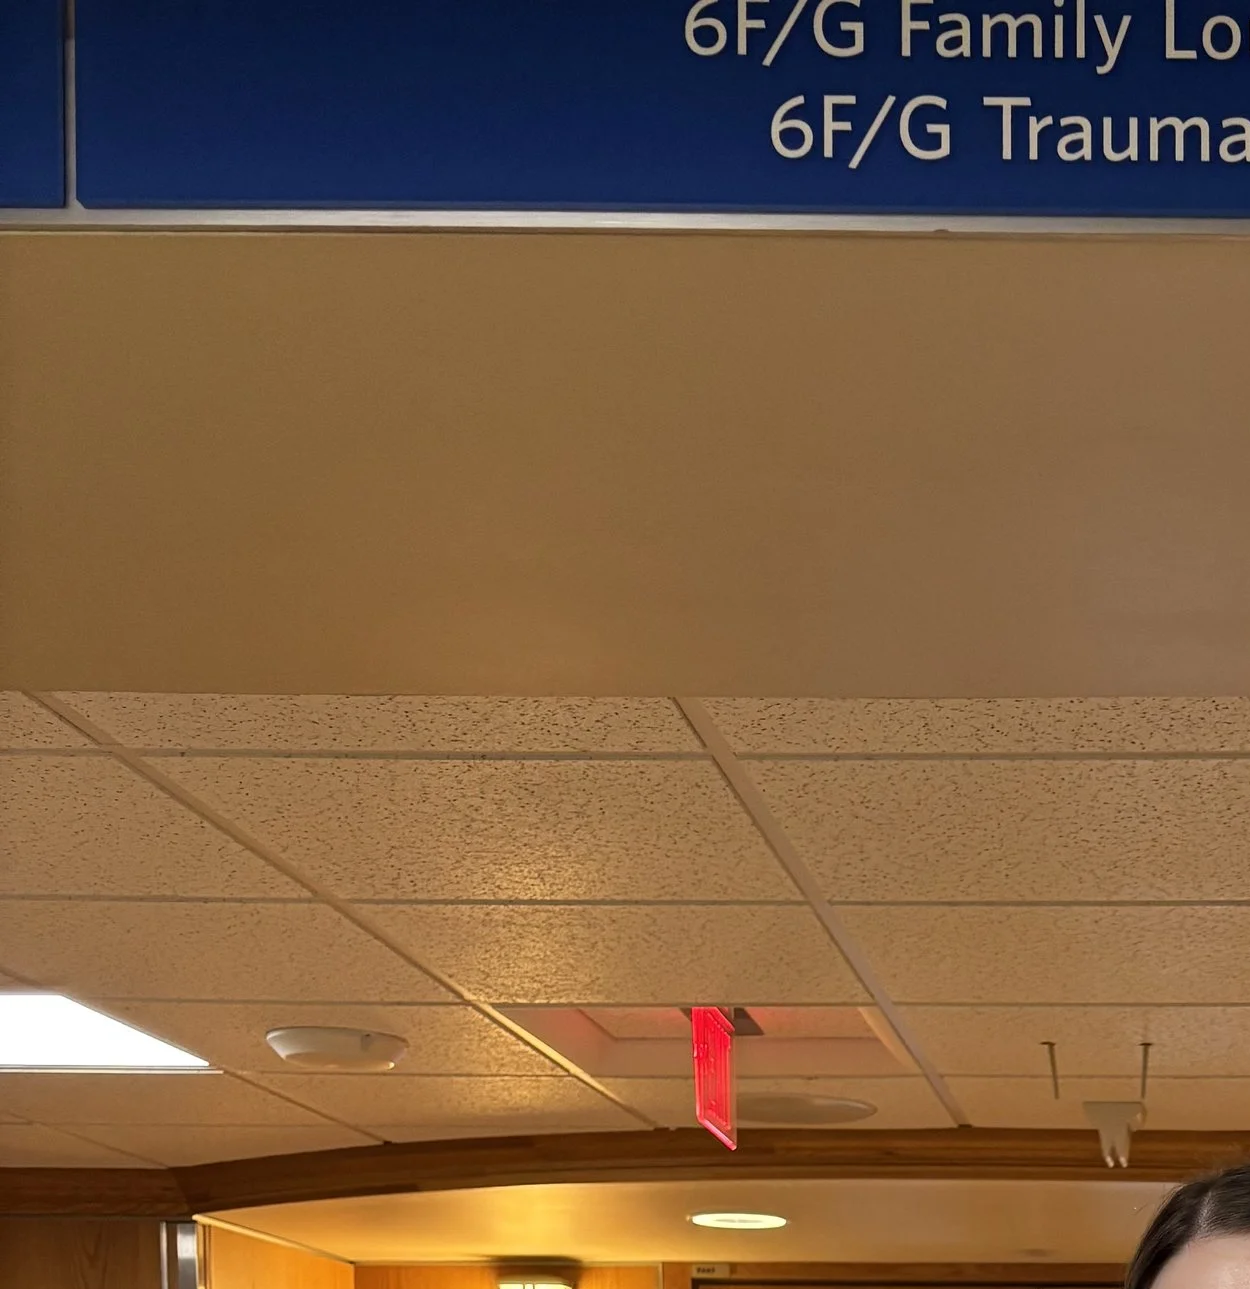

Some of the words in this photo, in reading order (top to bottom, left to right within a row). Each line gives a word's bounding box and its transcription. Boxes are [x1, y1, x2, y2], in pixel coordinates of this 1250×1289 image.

[685, 0, 864, 67] 6F/G
[901, 0, 1131, 75] Family
[771, 95, 951, 169] 6F/G
